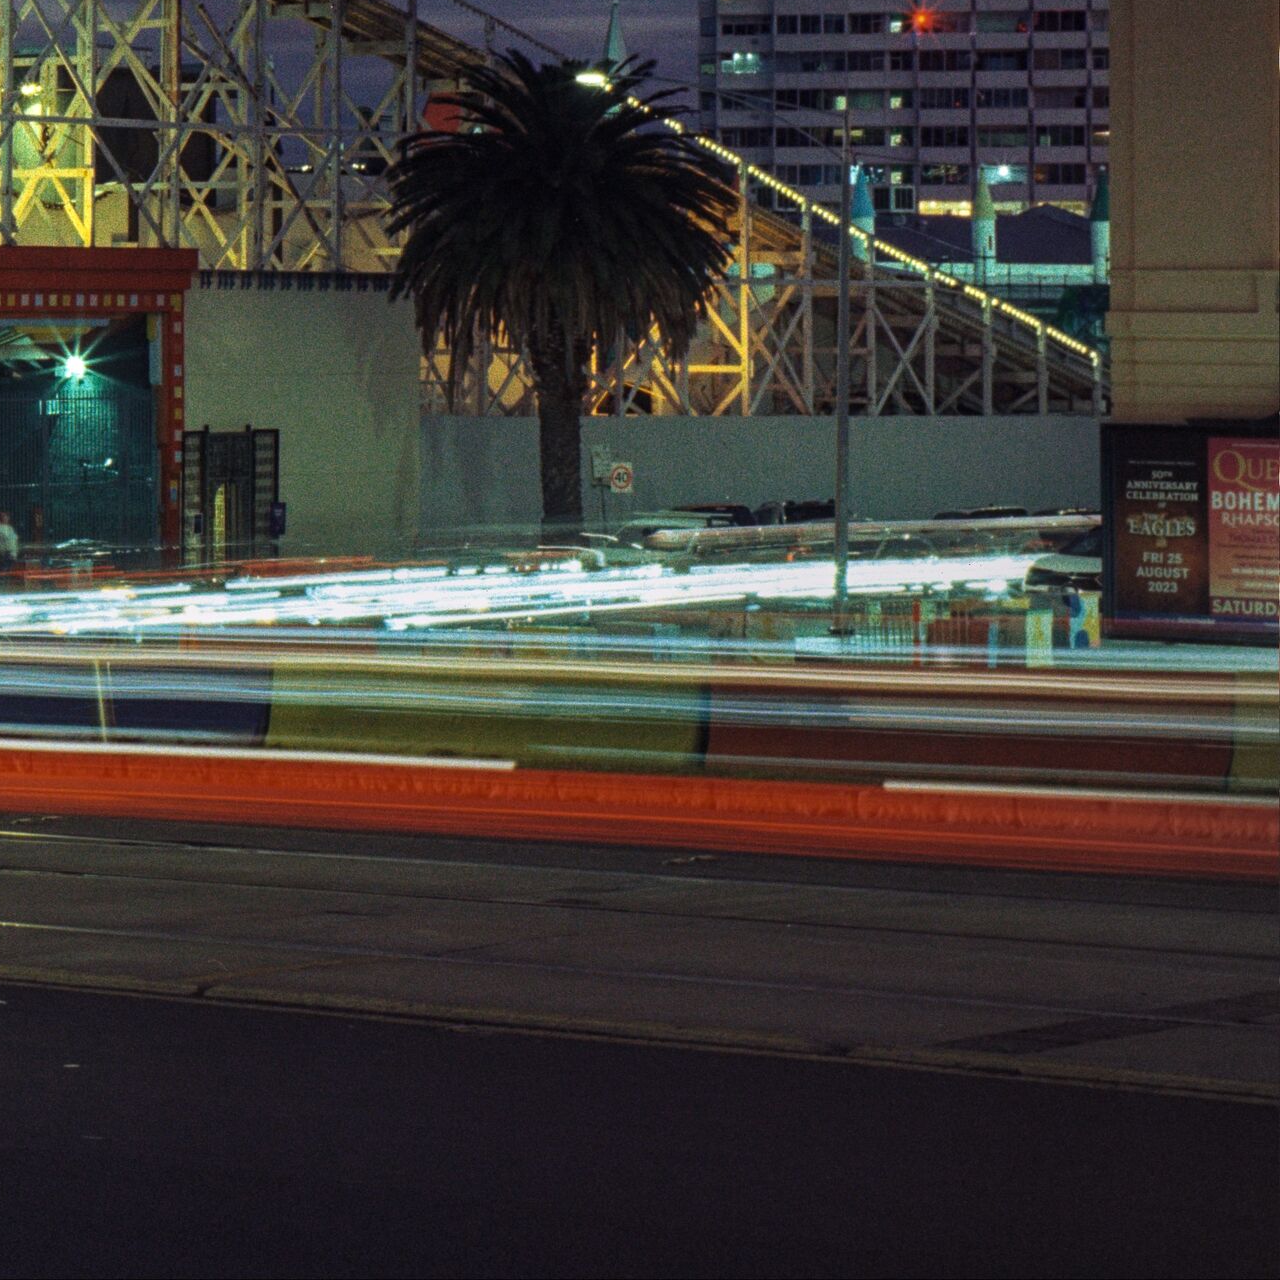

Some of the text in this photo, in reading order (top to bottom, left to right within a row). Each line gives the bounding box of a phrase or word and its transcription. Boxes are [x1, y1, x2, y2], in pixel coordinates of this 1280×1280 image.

[614, 471, 628, 483] 40
[1126, 480, 1198, 491] ANNIVERSARY
[1126, 491, 1199, 502] CELEBRATION
[1127, 518, 1197, 538] EAGLES
[1142, 551, 1163, 564] FRI
[1136, 566, 1190, 579] AUGUST
[1148, 581, 1178, 593] 2023
[1211, 599, 1279, 617] SATURD
